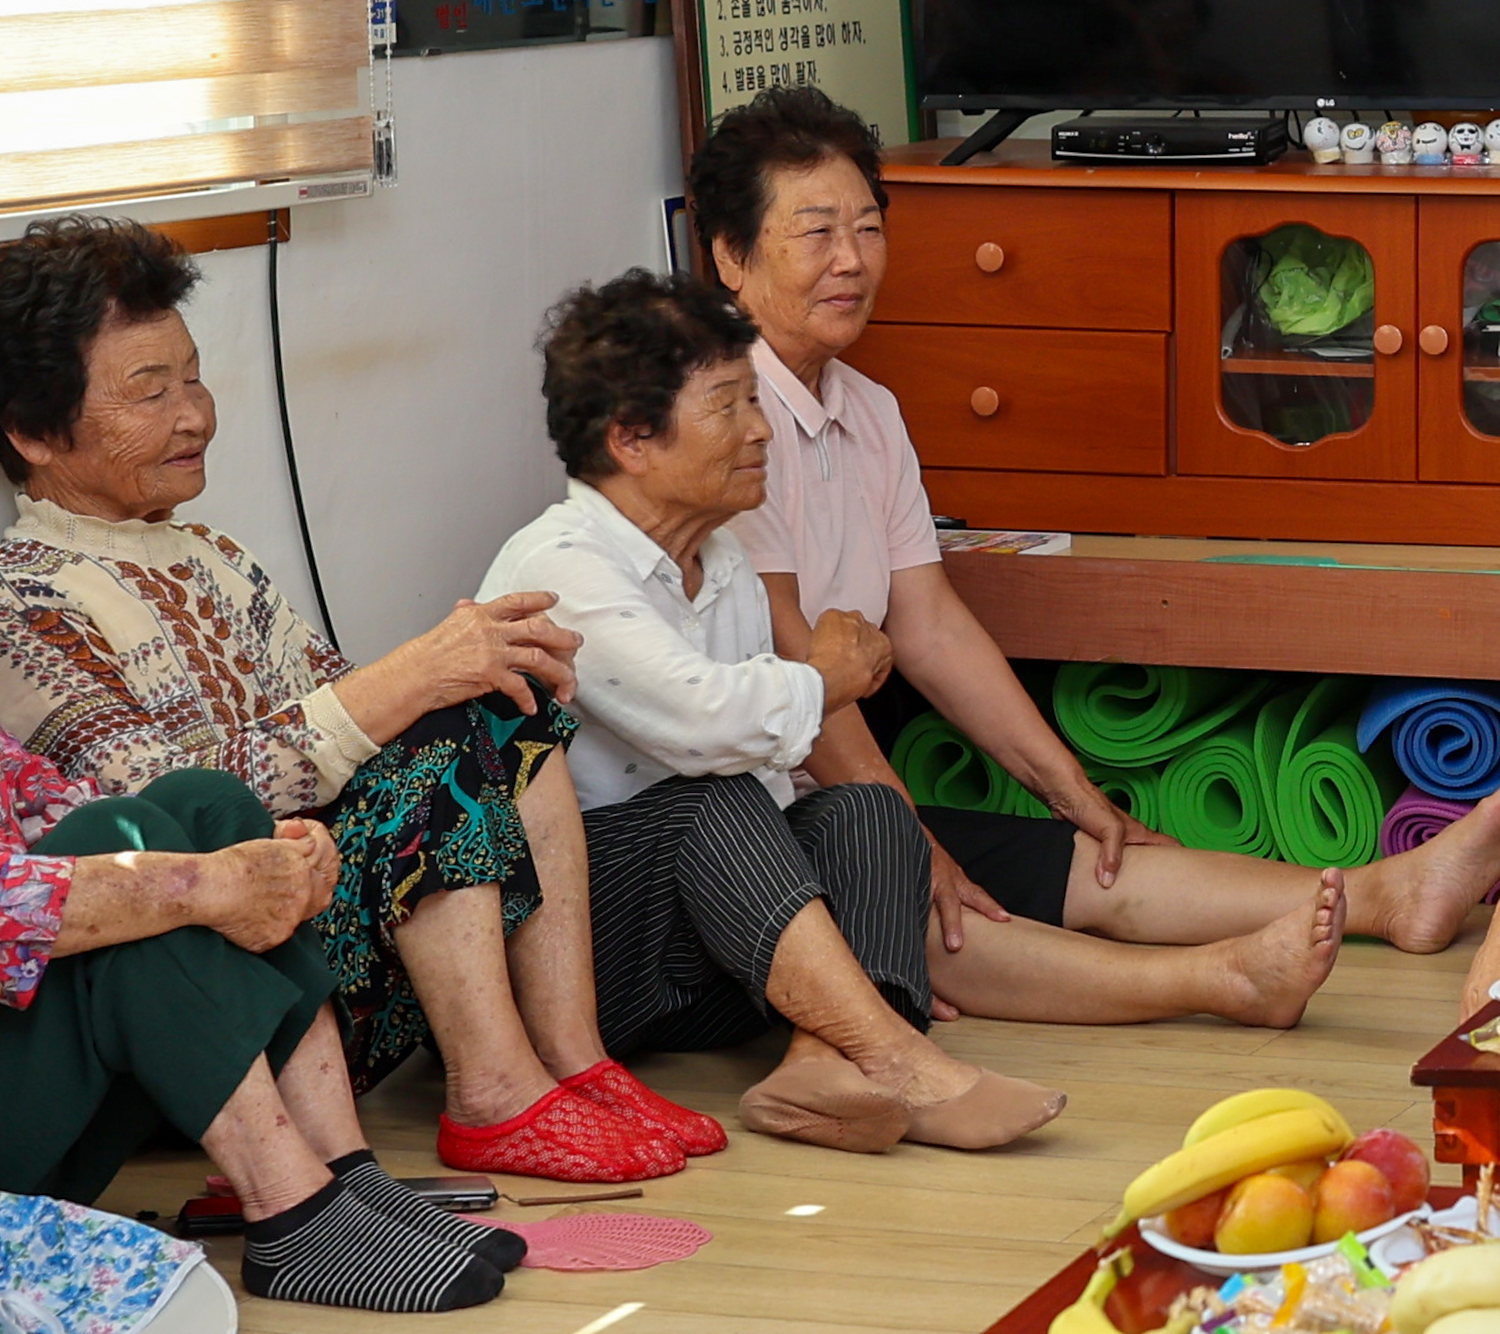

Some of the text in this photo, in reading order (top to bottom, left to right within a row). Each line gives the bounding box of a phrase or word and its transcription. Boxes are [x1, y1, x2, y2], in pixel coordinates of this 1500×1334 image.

[718, 0, 727, 21] 2.
[719, 21, 867, 58] 3. 긍정적인 생각을 많이 하자.
[722, 73, 732, 94] 4.
[770, 63, 791, 88] 많이
